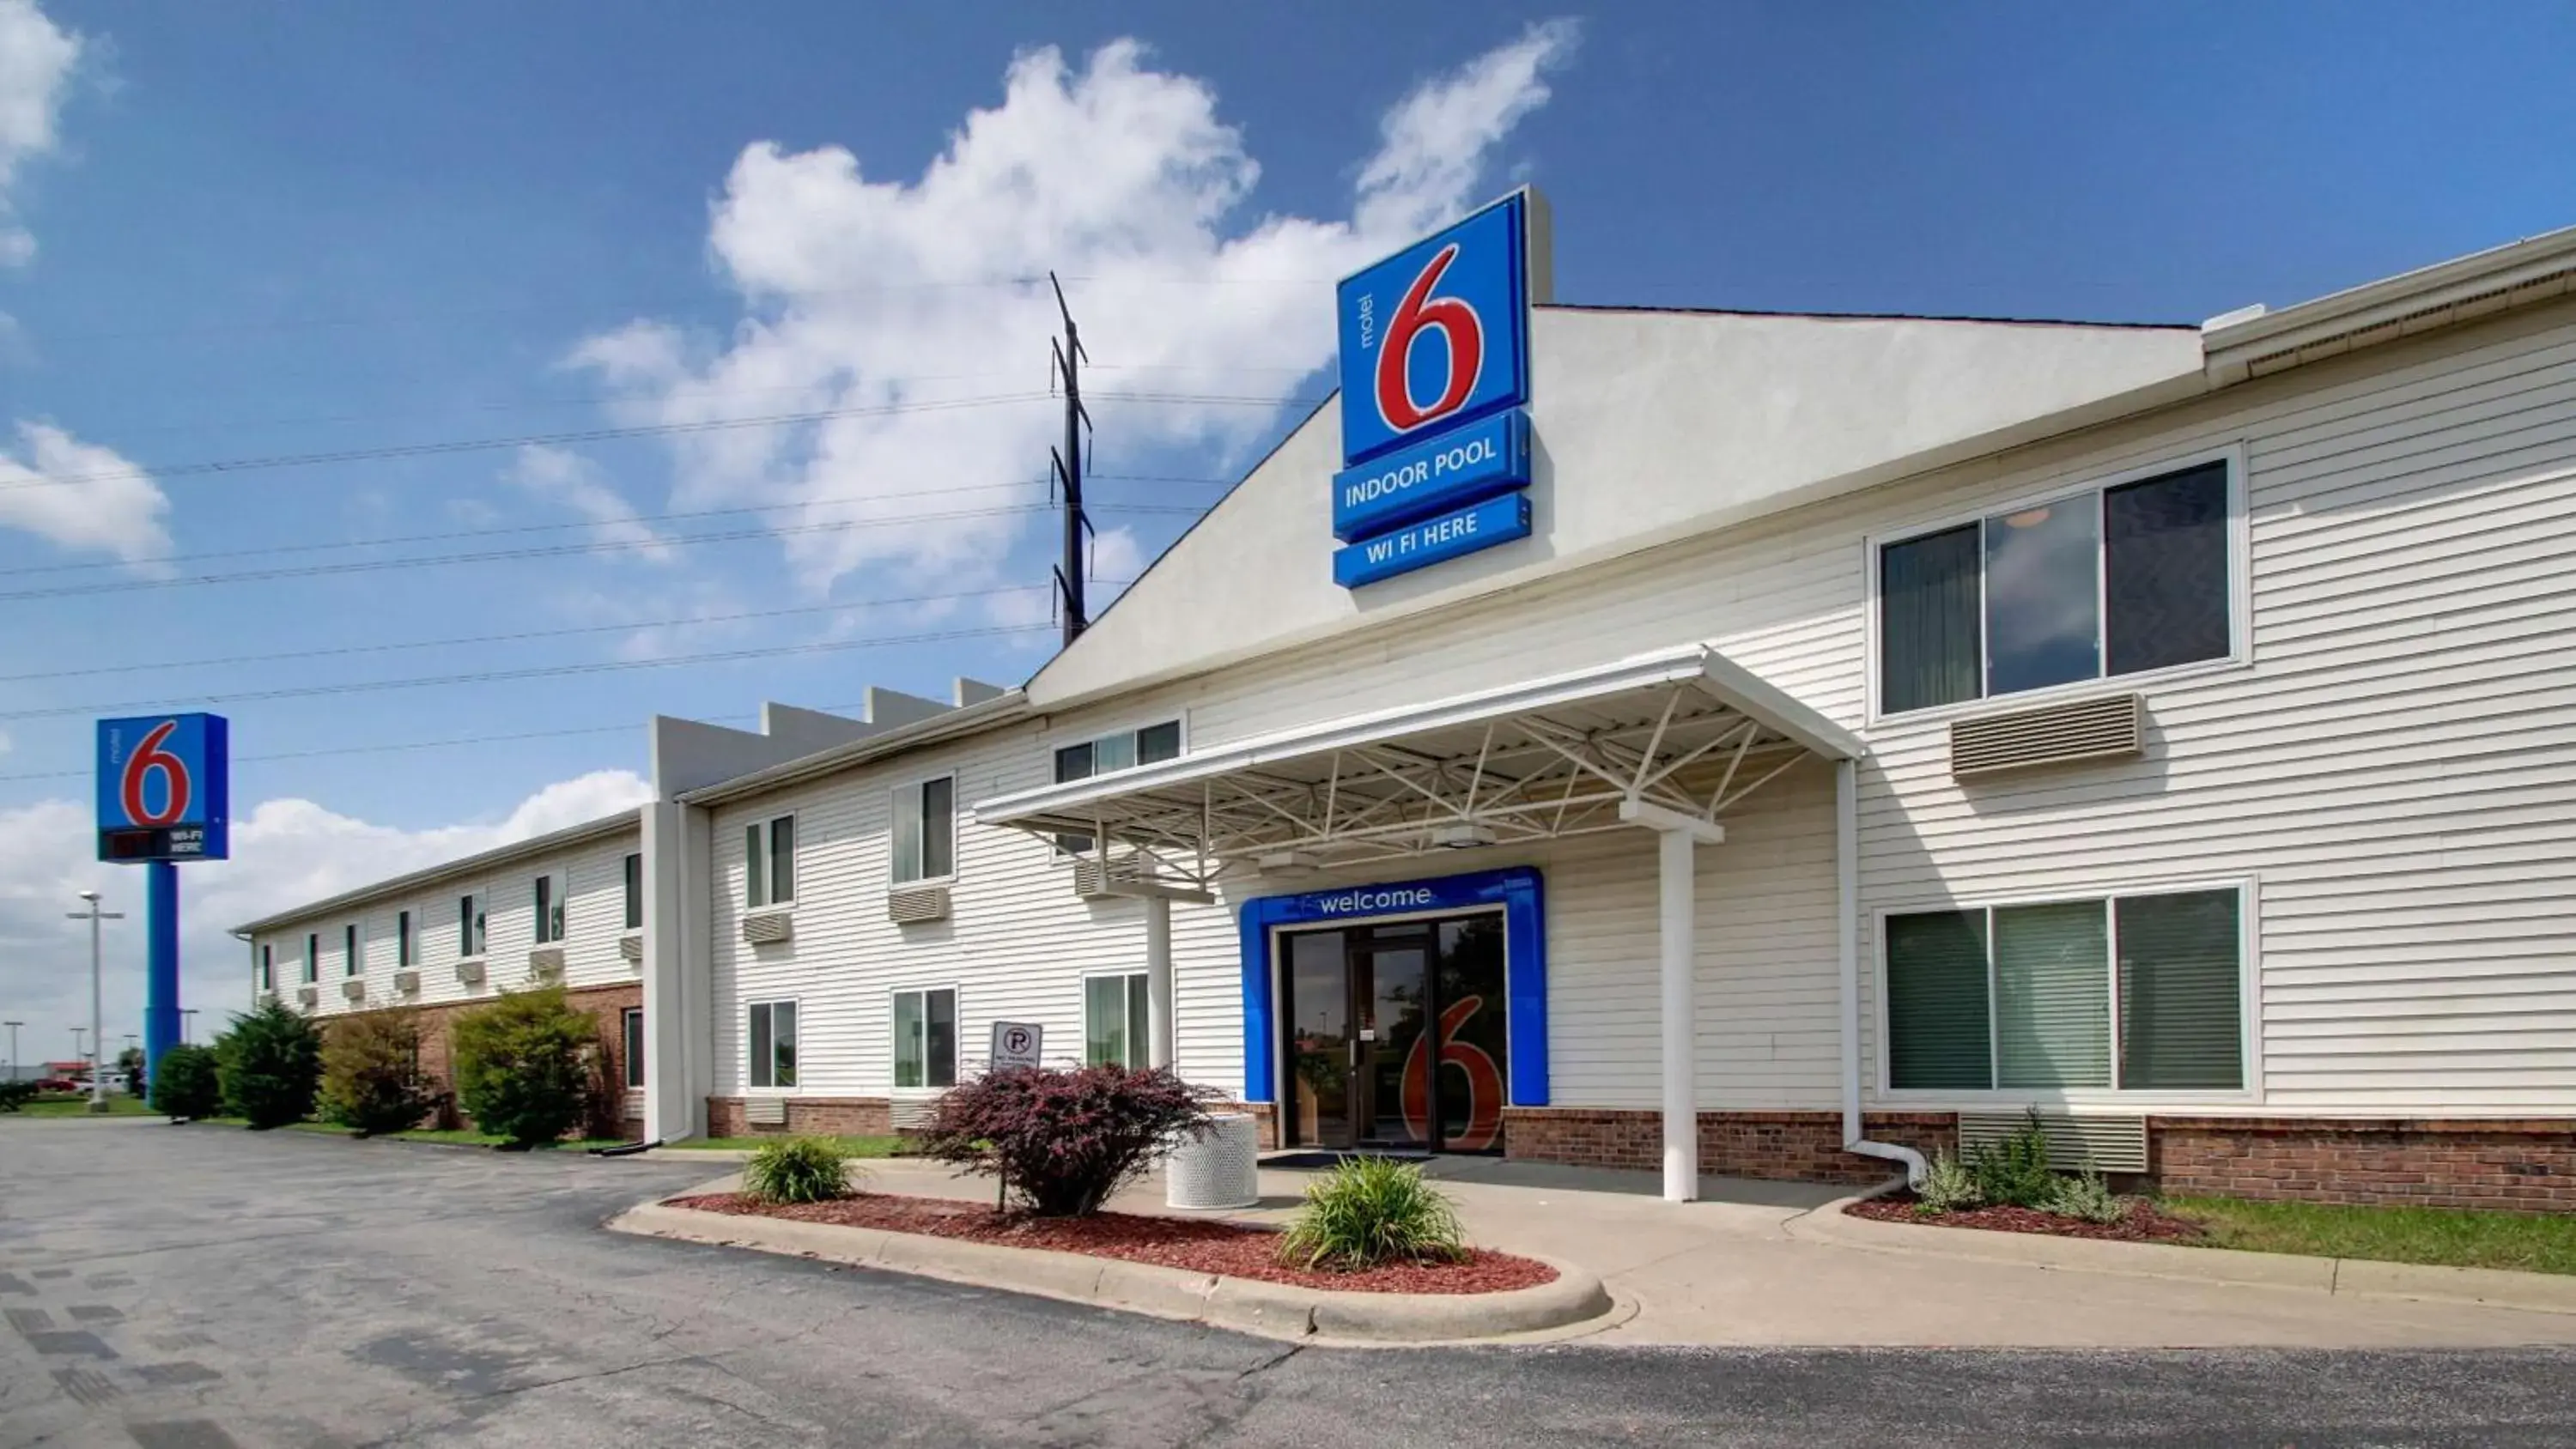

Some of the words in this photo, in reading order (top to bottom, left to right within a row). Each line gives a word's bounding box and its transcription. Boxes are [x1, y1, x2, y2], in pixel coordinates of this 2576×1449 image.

[1357, 292, 1374, 349] motel
[1376, 243, 1484, 433] 6
[1346, 461, 1428, 507] INDOOR
[1435, 437, 1497, 476] POOL
[1366, 539, 1393, 563] WI
[1400, 532, 1416, 554] FI
[1424, 512, 1478, 547] HERE
[120, 720, 191, 827] 6
[1321, 887, 1431, 913] welcome
[1401, 995, 1504, 1149] 6
